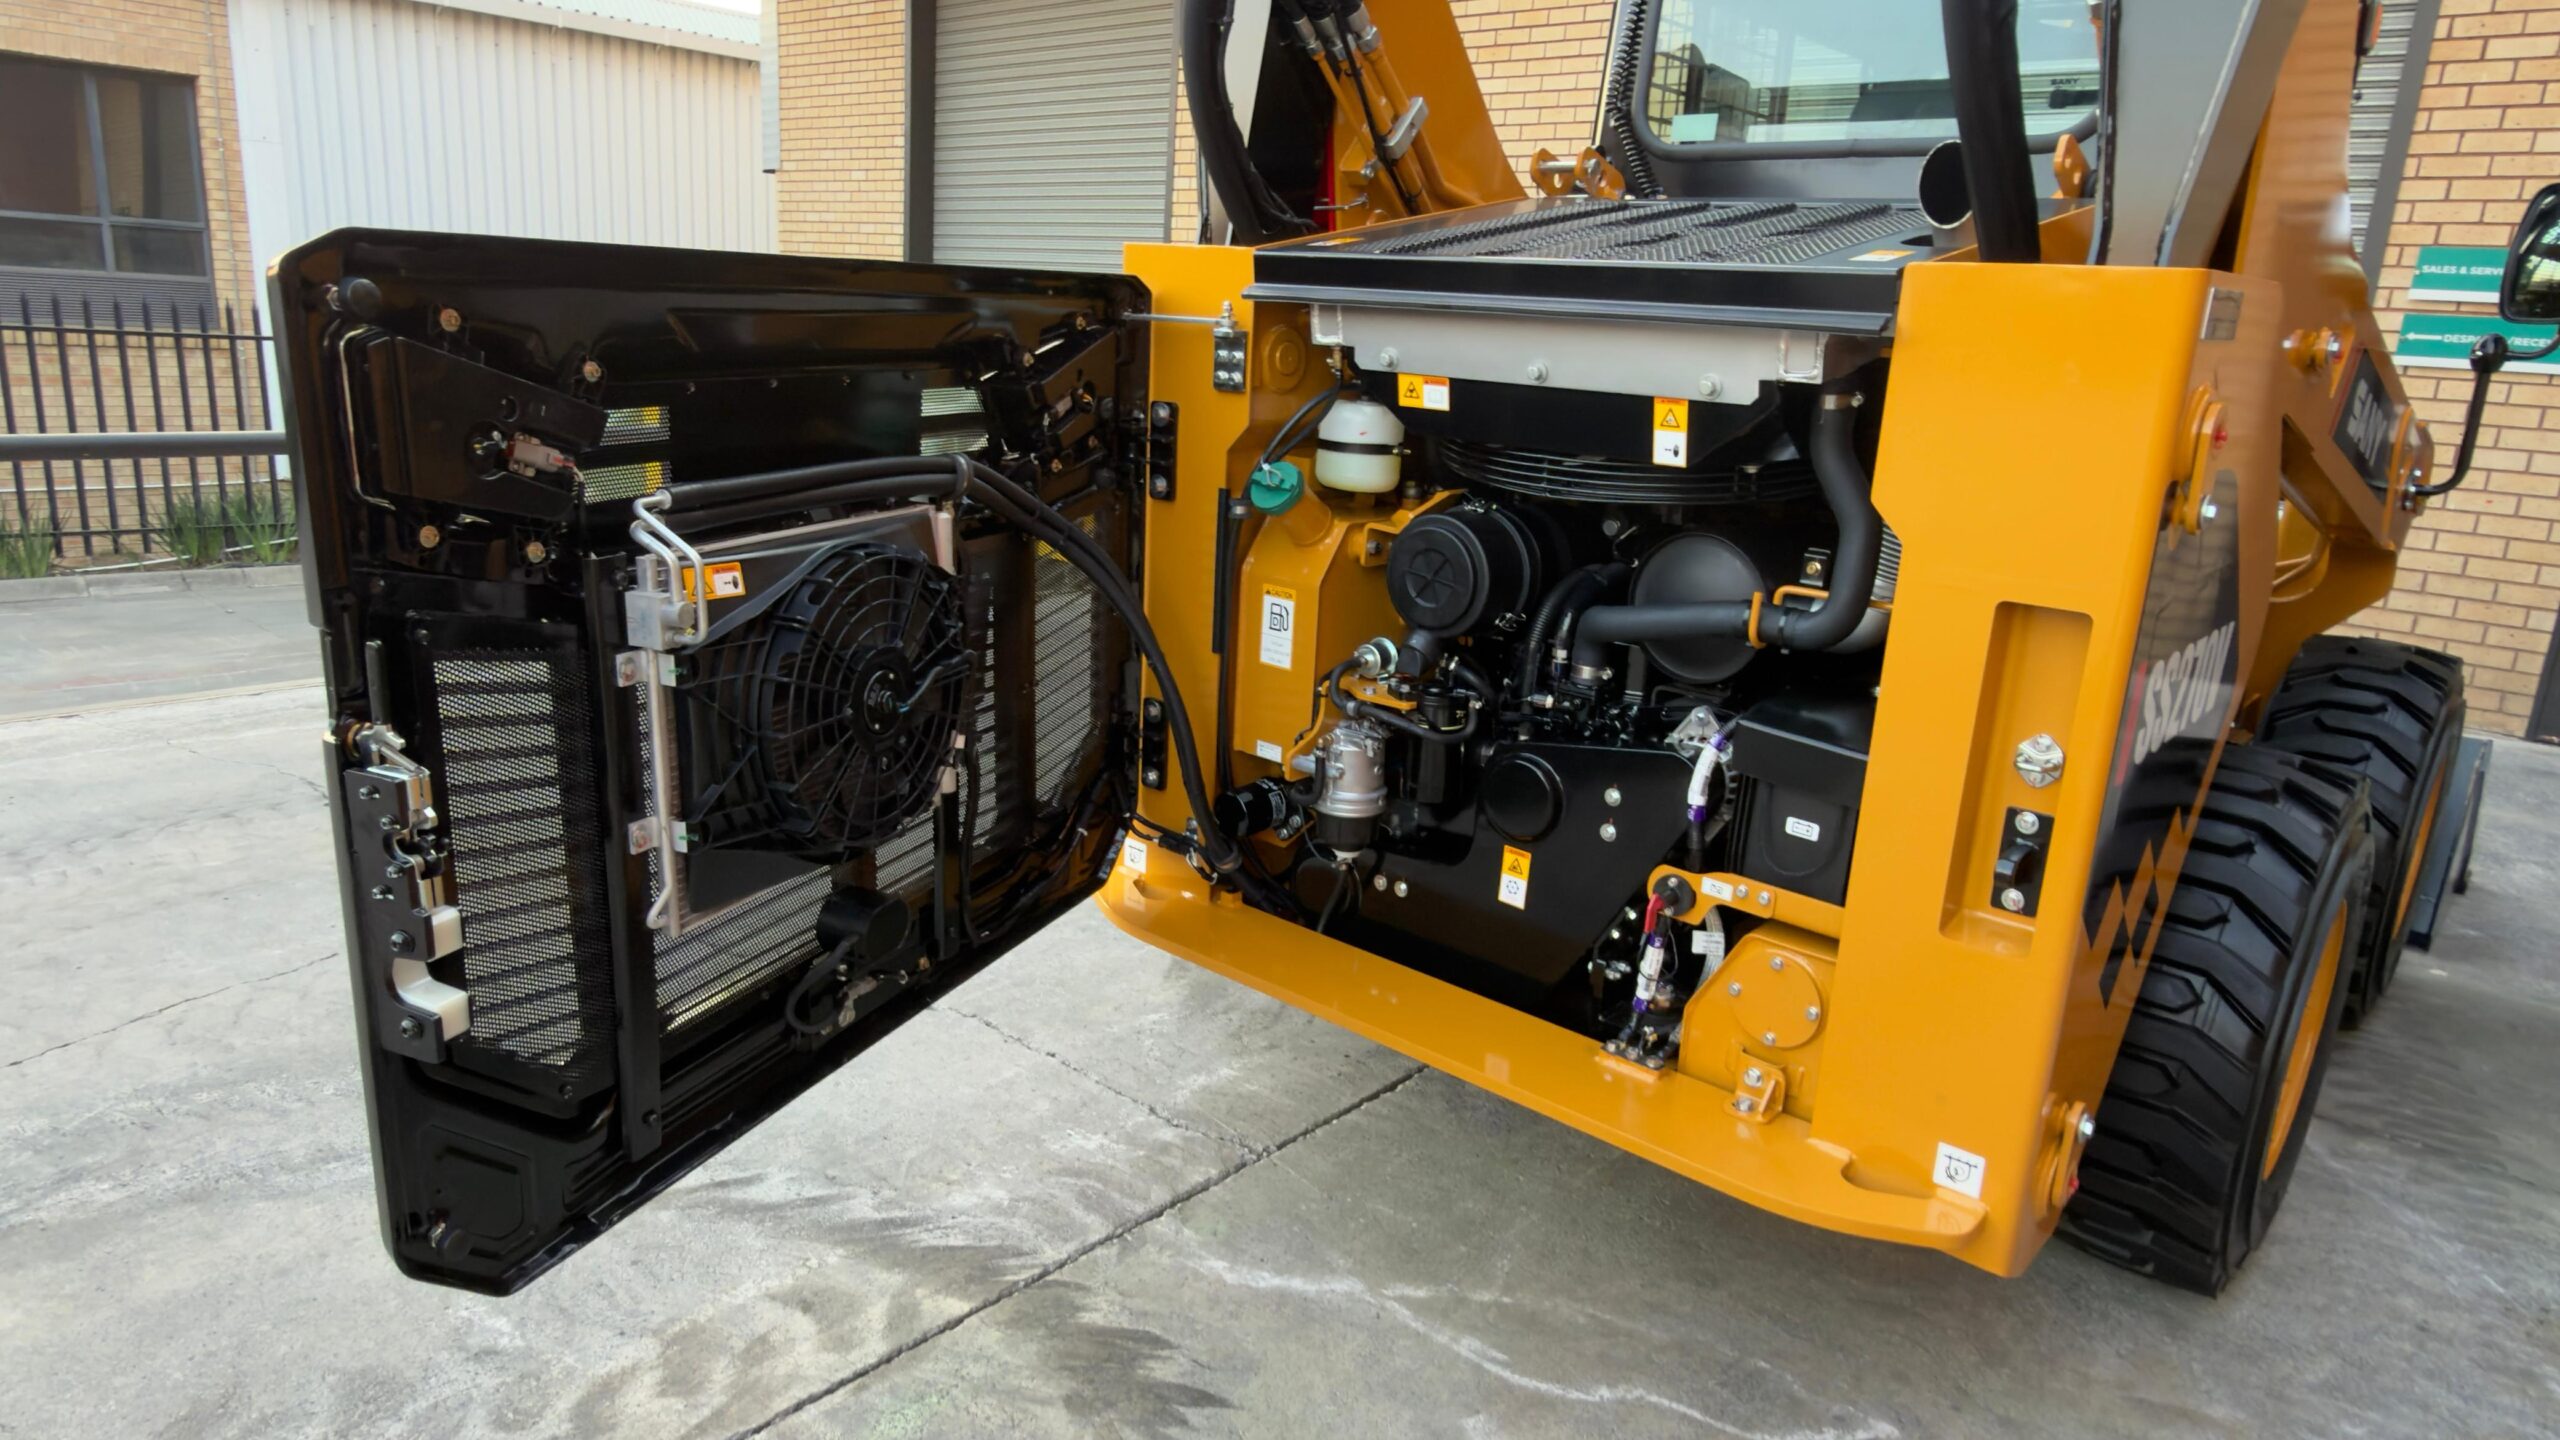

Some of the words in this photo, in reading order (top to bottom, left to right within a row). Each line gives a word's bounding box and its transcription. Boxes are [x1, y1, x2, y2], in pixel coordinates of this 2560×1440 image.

[2421, 264, 2457, 275] SALES
[2459, 266, 2468, 275] &
[2133, 620, 2235, 765] SS270V
